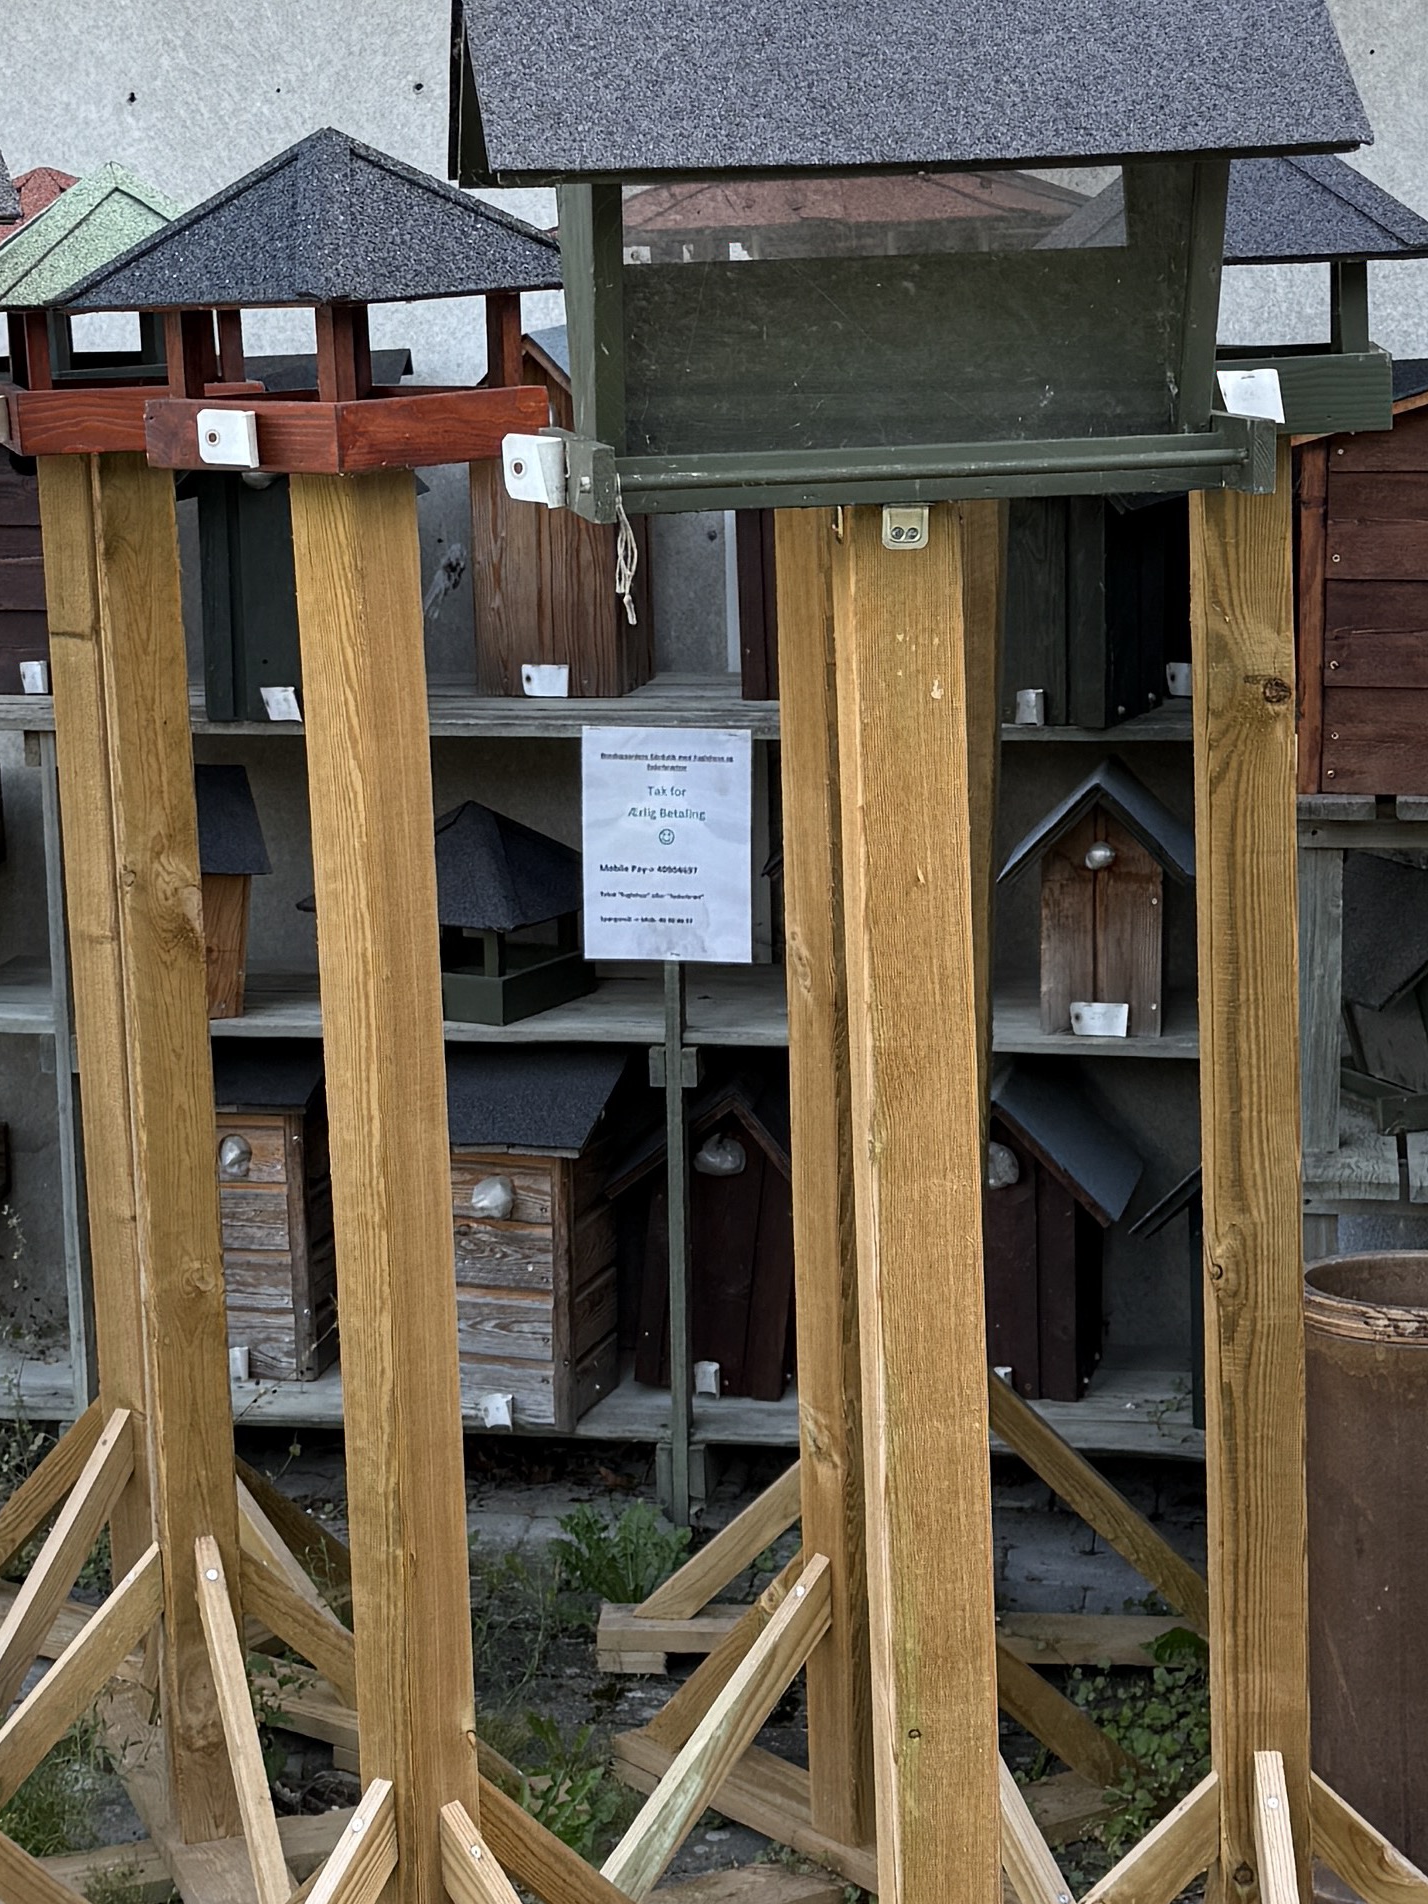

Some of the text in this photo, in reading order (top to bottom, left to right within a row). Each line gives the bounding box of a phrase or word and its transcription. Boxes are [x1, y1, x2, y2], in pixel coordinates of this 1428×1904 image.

[647, 786, 687, 797] Tak for
[628, 807, 706, 821] Ærlig Betaling
[599, 864, 629, 872] Mobile
